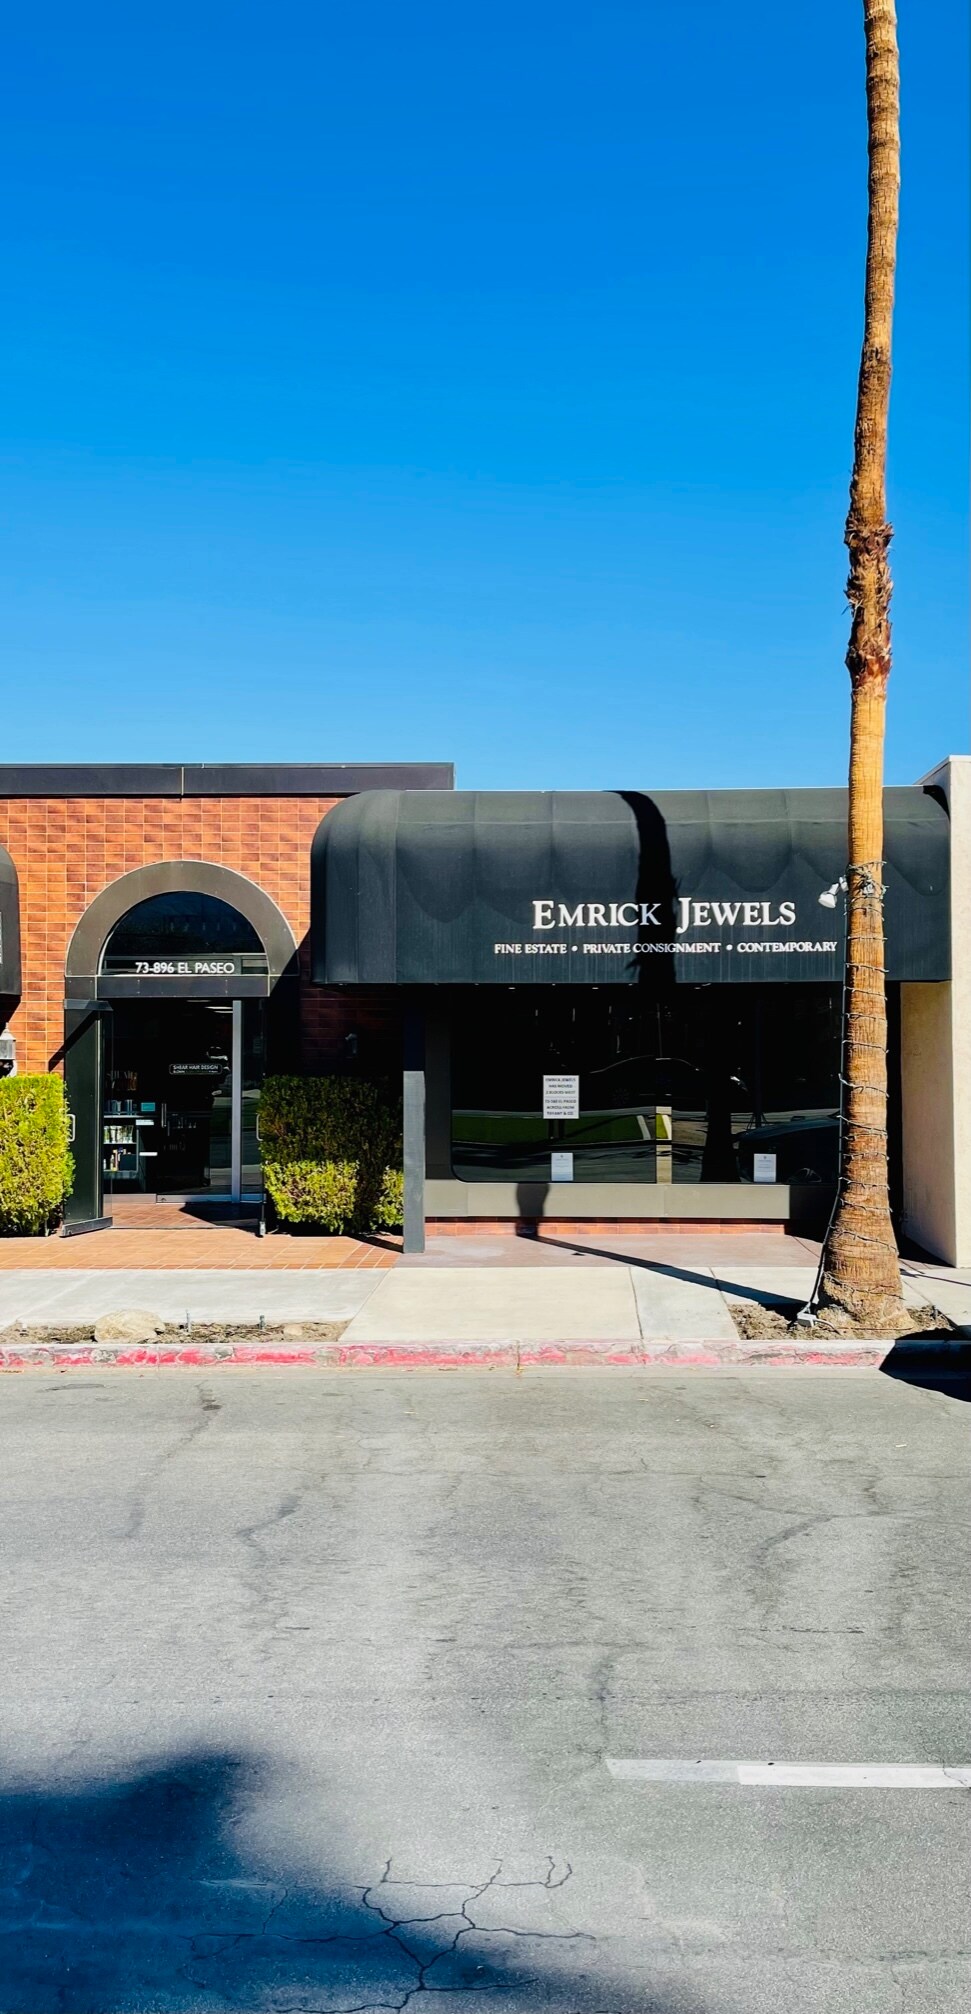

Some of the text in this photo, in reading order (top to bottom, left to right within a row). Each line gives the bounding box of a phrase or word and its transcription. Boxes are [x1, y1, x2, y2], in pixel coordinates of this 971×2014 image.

[532, 897, 796, 934] EMRICK JEWELS
[494, 941, 837, 954] FINE ESTATE PRIVATE CONSIGNMENT CONTEMPORARY
[135, 962, 235, 974] 73-896 EL PASEO
